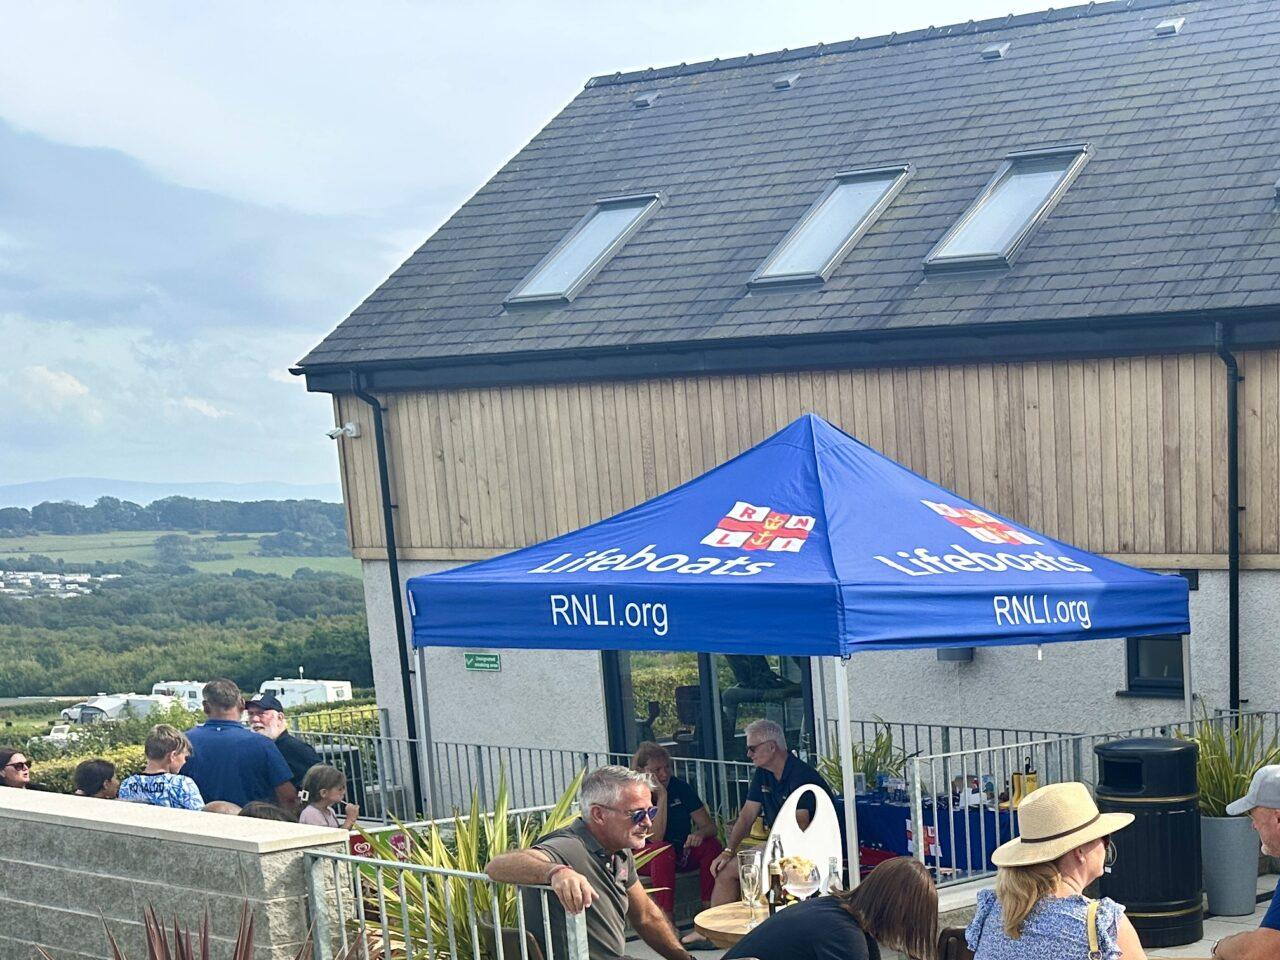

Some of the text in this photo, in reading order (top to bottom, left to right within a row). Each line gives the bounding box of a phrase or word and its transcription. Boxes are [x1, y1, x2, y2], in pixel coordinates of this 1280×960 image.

[739, 506, 810, 527] R N
[716, 533, 791, 549] L I
[527, 544, 776, 576] Lifeboats
[873, 544, 1093, 577] Lifeboats
[550, 594, 669, 636] RNLI.org
[993, 594, 1092, 629] RNLI.org
